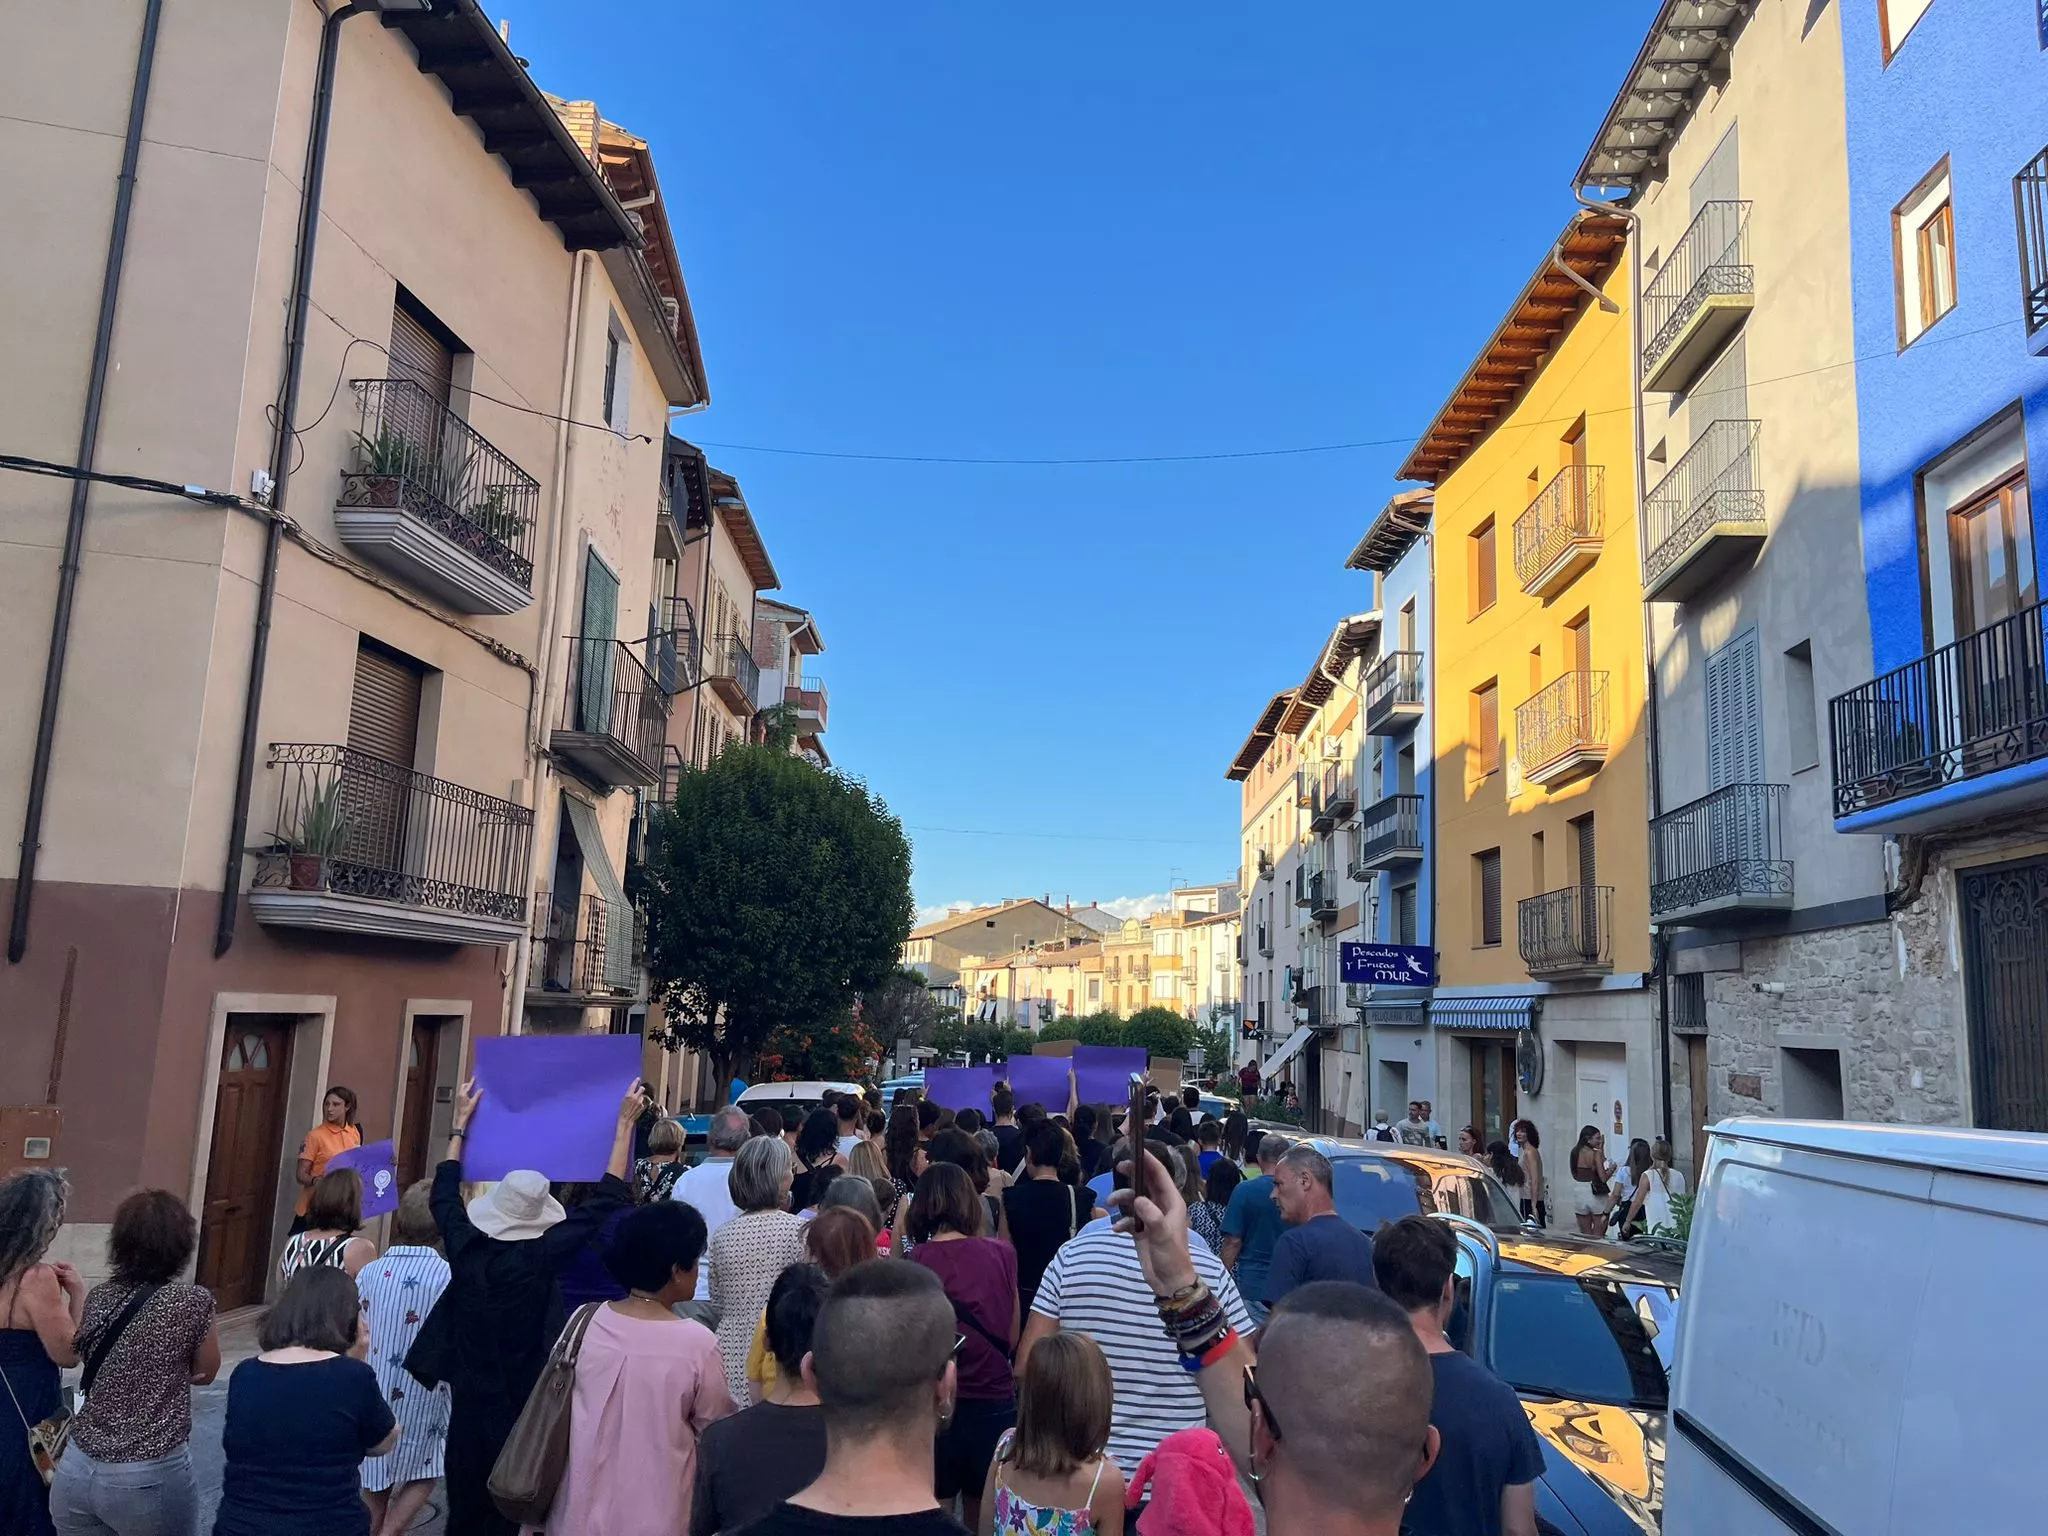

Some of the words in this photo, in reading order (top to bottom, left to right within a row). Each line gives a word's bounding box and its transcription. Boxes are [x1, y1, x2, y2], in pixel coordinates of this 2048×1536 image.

[1352, 946, 1399, 957] Pescados
[1357, 959, 1395, 970] Frutas
[1375, 970, 1413, 982] MUR
